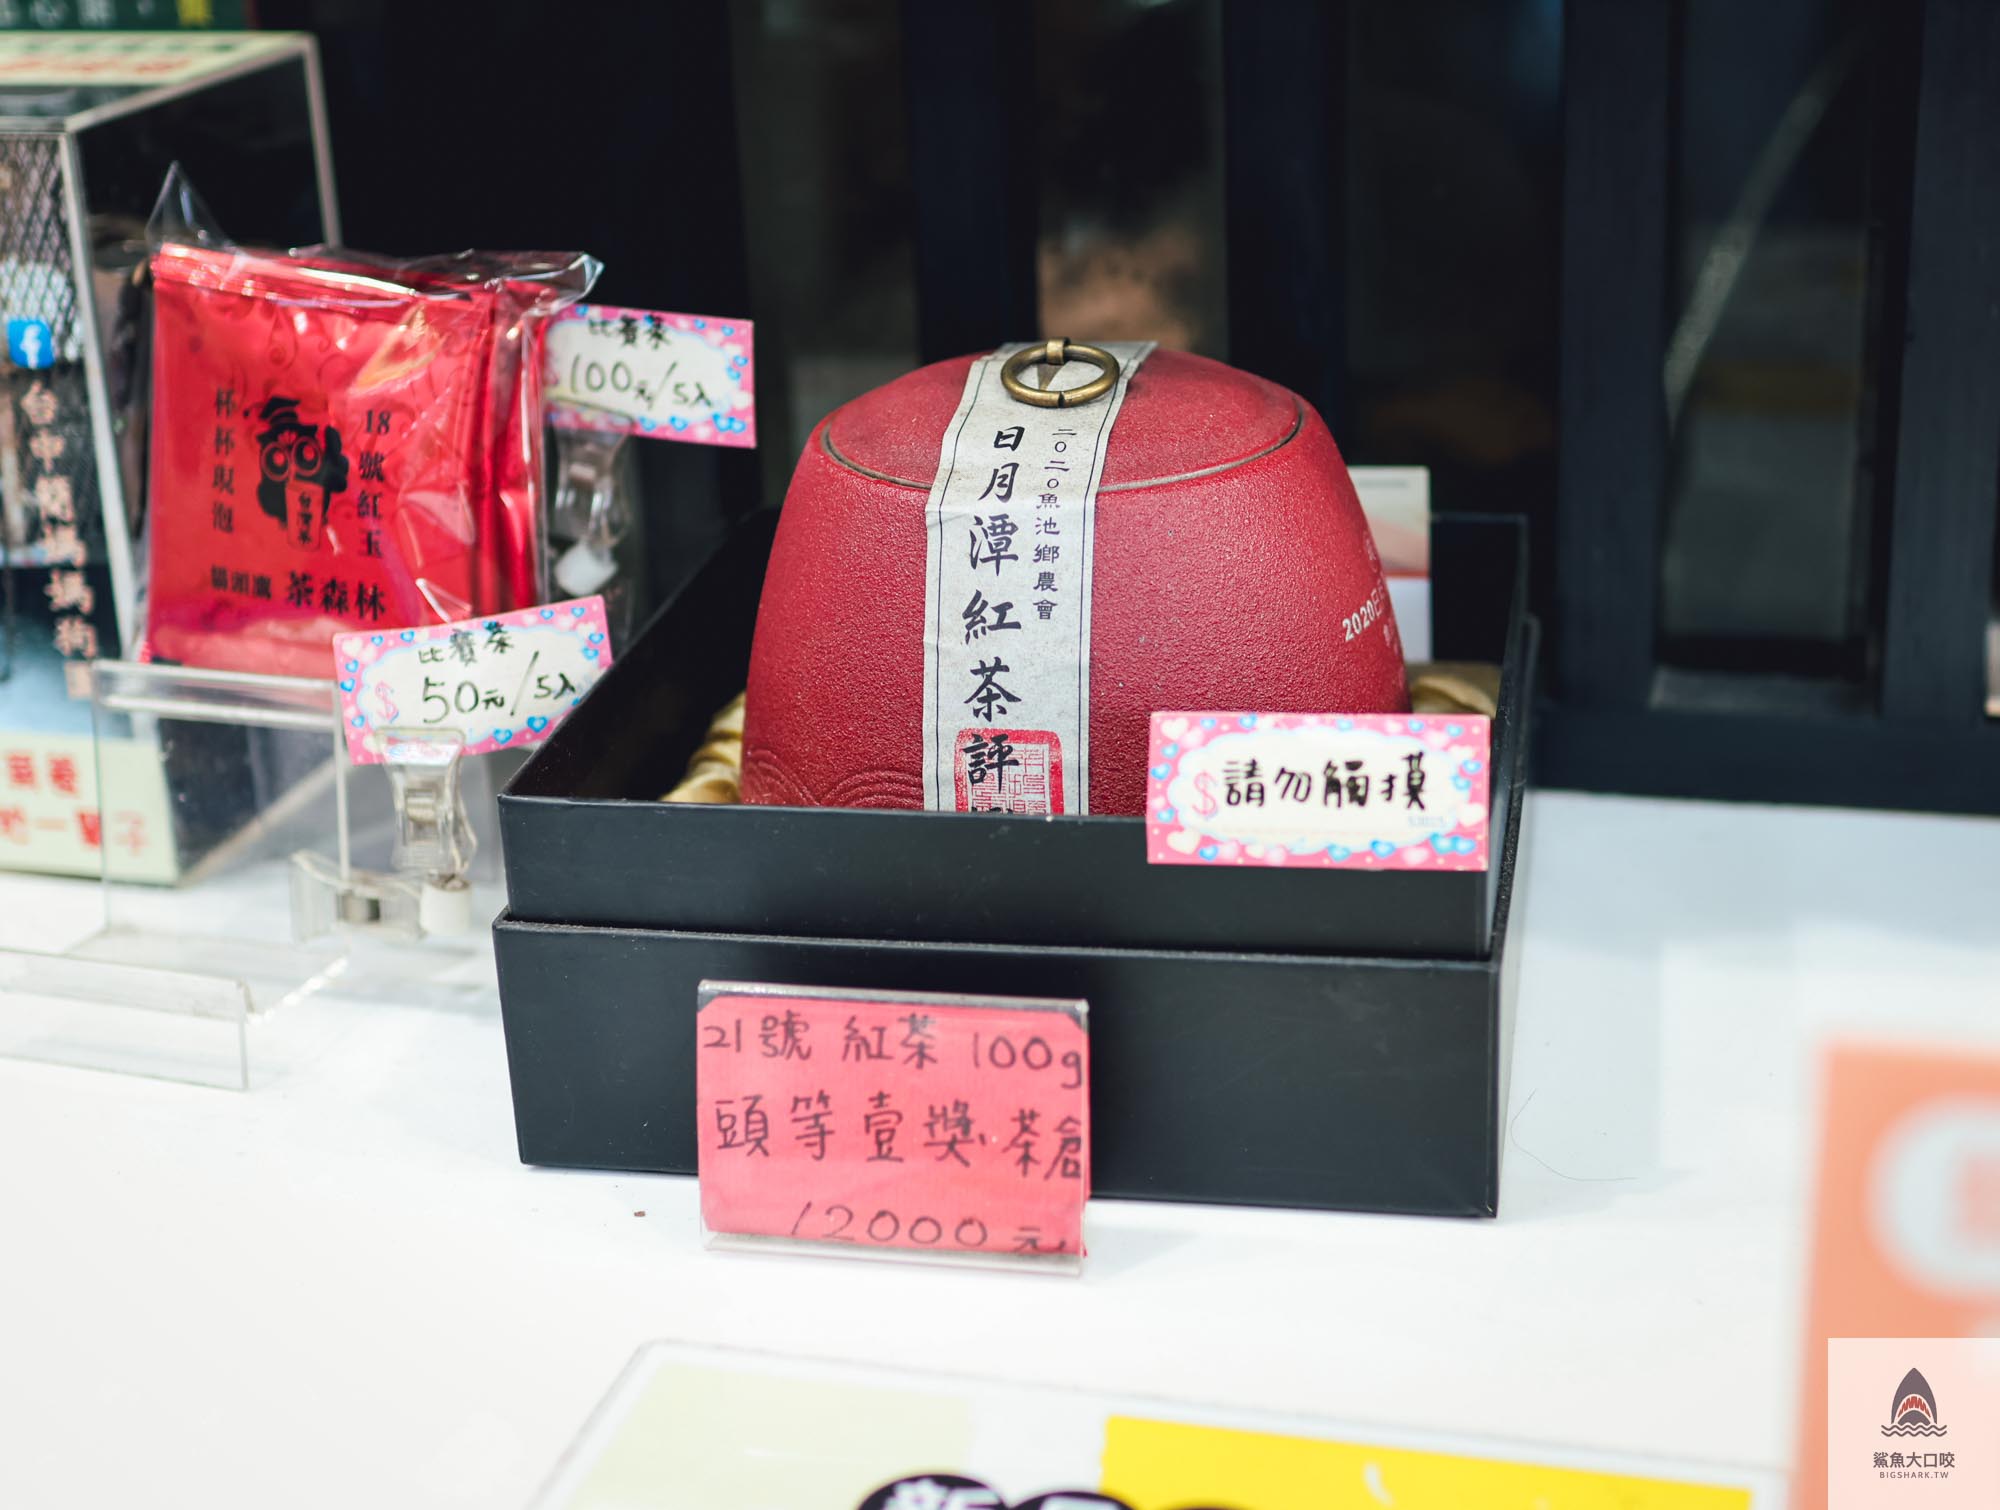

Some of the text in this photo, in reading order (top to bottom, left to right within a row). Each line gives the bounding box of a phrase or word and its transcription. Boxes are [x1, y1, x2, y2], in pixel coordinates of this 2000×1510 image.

[212, 388, 235, 533] 杯杯現泡
[357, 409, 393, 558] 18號紅玉
[287, 571, 386, 621] 茶森林
[961, 426, 1025, 813] 日月潭紅茶評
[1222, 752, 1426, 810] 請勿觸摸
[972, 1031, 1083, 1090] 100g
